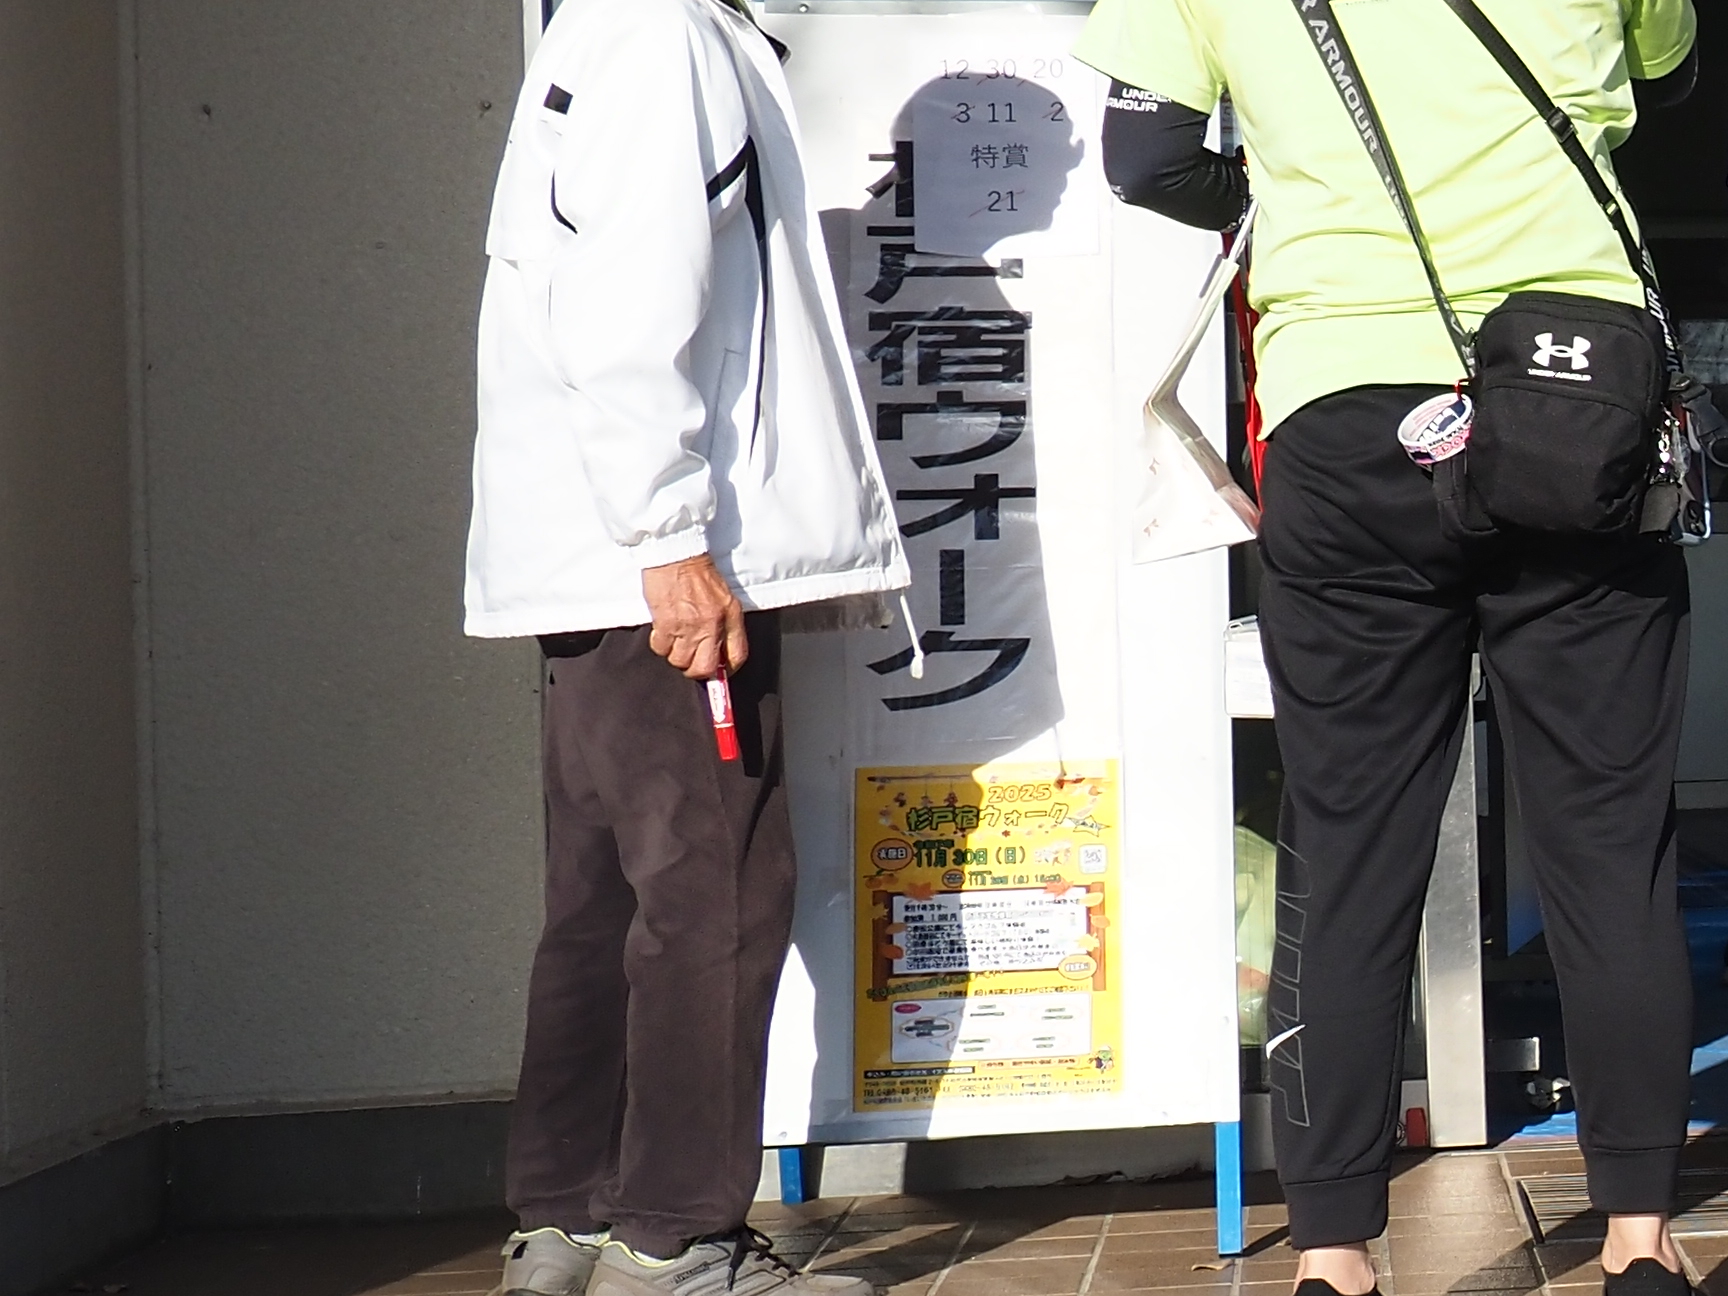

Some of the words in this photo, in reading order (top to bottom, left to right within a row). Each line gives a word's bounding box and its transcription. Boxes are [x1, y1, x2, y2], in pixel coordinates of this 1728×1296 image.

[939, 59, 970, 80] 12
[986, 58, 1017, 80] 30
[1121, 87, 1172, 103] UNDE
[1309, 19, 1378, 153] ARMOUR
[956, 102, 971, 123] 3
[987, 102, 1017, 123] 11
[1050, 101, 1064, 122] 2
[1106, 97, 1159, 113] RMOUR
[970, 143, 1029, 168] 特賞
[987, 190, 1019, 212] 21
[989, 784, 1052, 803] 2025
[906, 802, 1069, 831] 杉戸宿ウォーク
